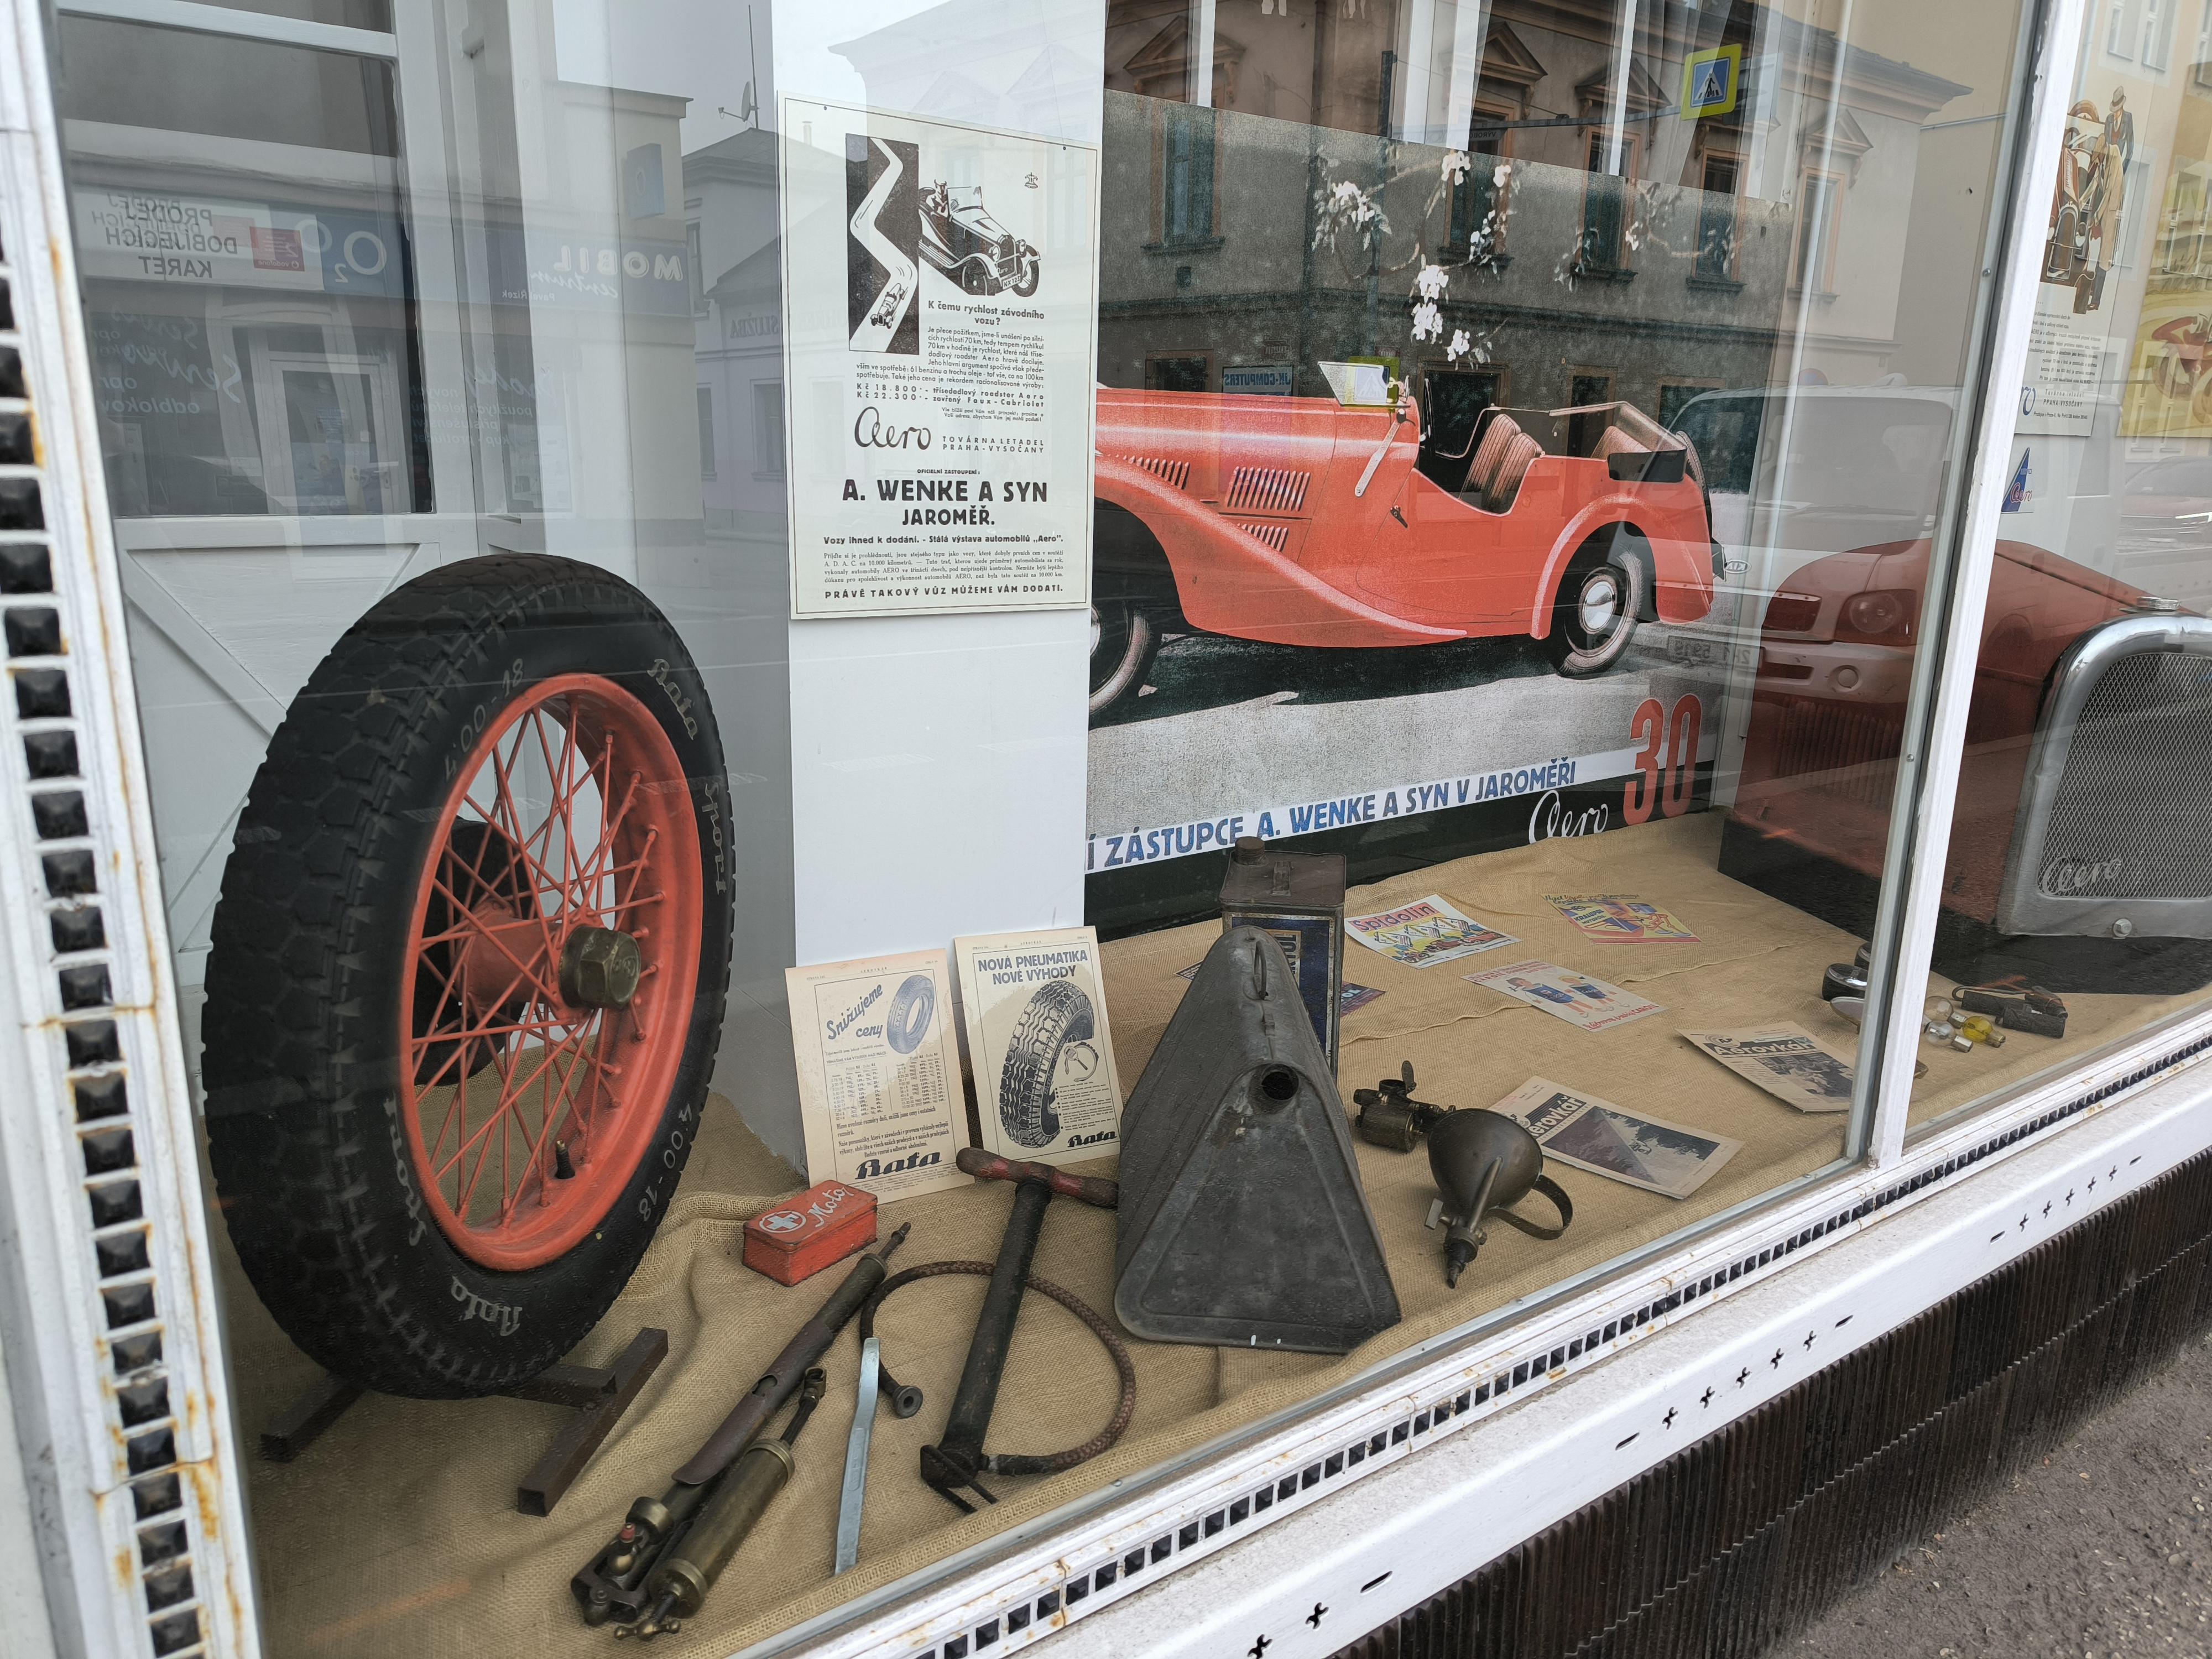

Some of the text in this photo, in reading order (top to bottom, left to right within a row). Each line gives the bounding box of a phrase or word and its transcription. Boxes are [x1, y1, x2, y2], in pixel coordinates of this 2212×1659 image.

[928, 301, 1044, 319] K čemu rychlost závodního
[974, 316, 1000, 326] vozu?
[854, 406, 932, 451] Aero
[942, 435, 1044, 446] TOVÁRNA LETADEL
[843, 479, 1047, 502] A. WENKE A SYN
[902, 505, 995, 526] JAROMĚŘ.
[823, 536, 845, 545] Vozy
[951, 535, 982, 543] výstava
[825, 582, 1063, 599] PRÁVĚ TAKOVÝ VŮZ MŮŽEME VÁM DODATI.
[1623, 693, 1702, 826] 30
[1105, 816, 1244, 867] ZÁSTUPCE
[1256, 812, 1281, 839] A.
[1289, 794, 1376, 834] WENKE
[1383, 791, 1399, 818] A
[1406, 782, 1449, 814] SYN
[1457, 779, 1470, 804] V
[1475, 756, 1576, 801] JAROMĚŘI
[1354, 904, 1435, 933] Spidolin
[978, 950, 1088, 972] NOVÁ PNEUMATIKA
[993, 964, 1076, 984] NOVÉ VÝHODY
[855, 1024, 883, 1039] ceny
[1530, 1095, 1587, 1138] erovkář
